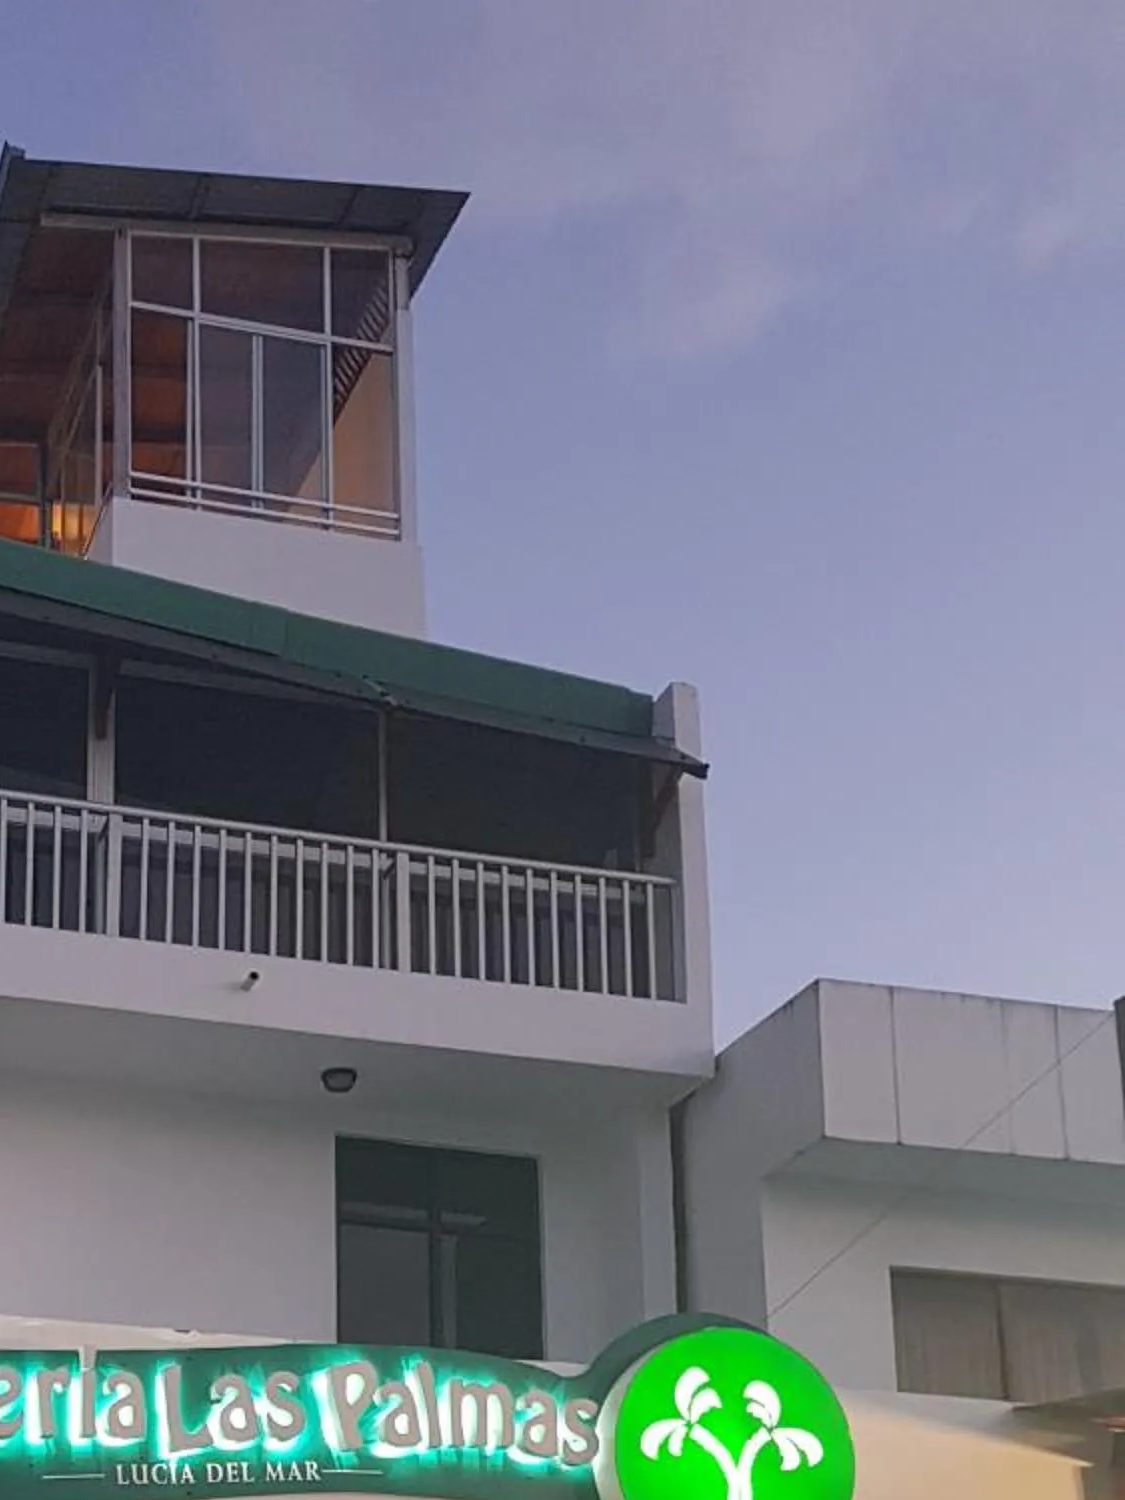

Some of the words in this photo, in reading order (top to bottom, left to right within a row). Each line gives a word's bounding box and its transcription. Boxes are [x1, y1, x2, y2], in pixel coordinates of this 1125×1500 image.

[166, 1363, 306, 1453] Las
[326, 1360, 601, 1467] Palmas
[206, 1460, 255, 1484] DEL
[265, 1459, 322, 1483] MAR
